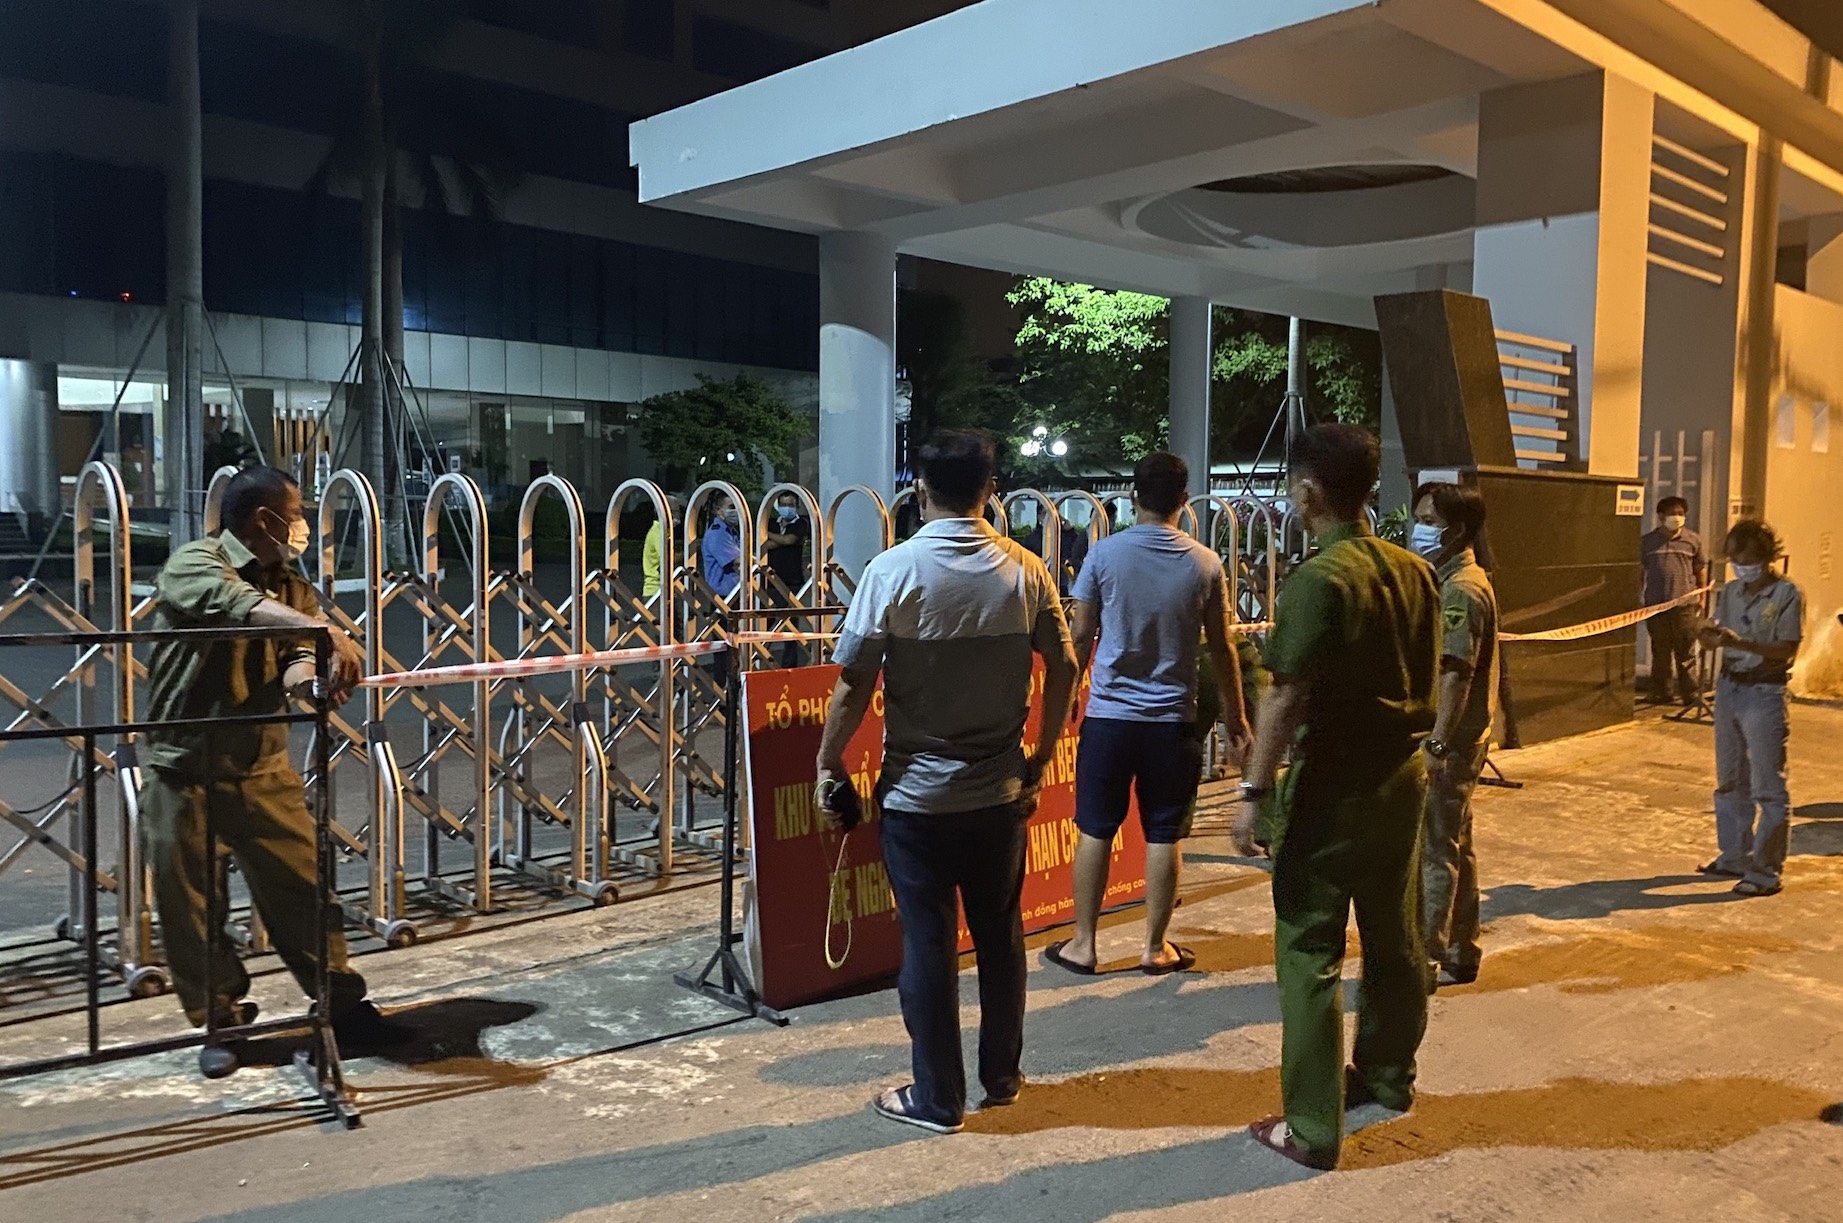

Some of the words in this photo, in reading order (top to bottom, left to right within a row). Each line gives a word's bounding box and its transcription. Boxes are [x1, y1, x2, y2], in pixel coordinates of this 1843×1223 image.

[766, 684, 793, 730] TỔ
[774, 782, 811, 840] KHU
[1030, 820, 1060, 880] HẠN
[1034, 901, 1057, 917] đồng
[1058, 896, 1074, 909] hàn
[1107, 880, 1132, 896] chống
